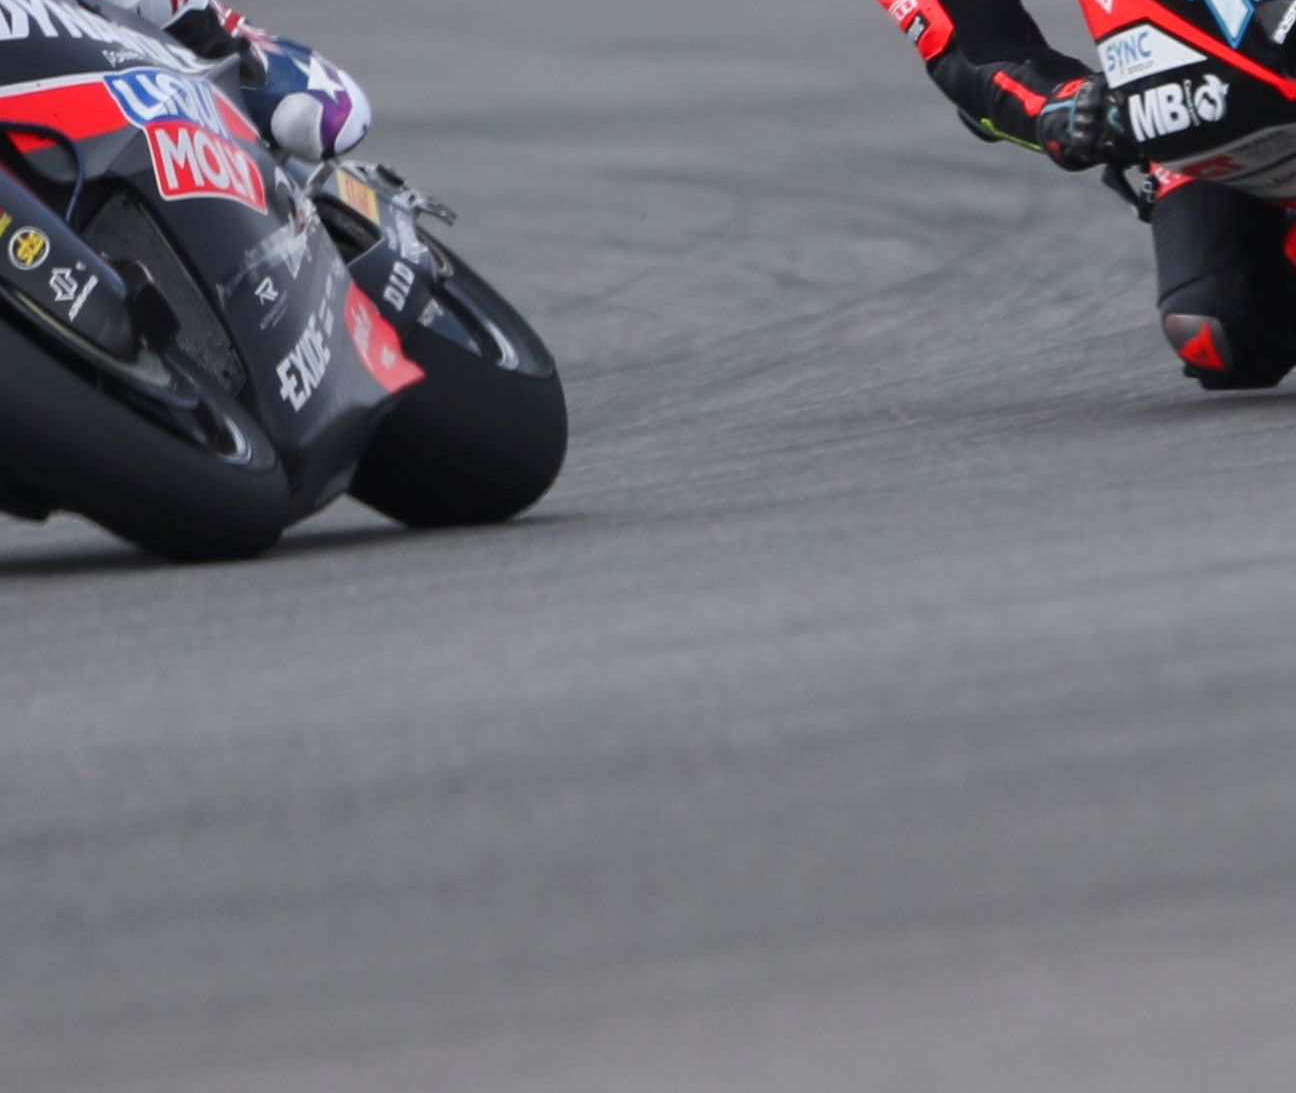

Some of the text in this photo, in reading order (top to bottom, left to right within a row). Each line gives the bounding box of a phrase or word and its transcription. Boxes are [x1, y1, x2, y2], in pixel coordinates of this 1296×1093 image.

[1106, 32, 1151, 72] SYNC
[1128, 82, 1192, 143] MB
[155, 128, 258, 202] MOLY
[276, 323, 331, 412] EXIDE
